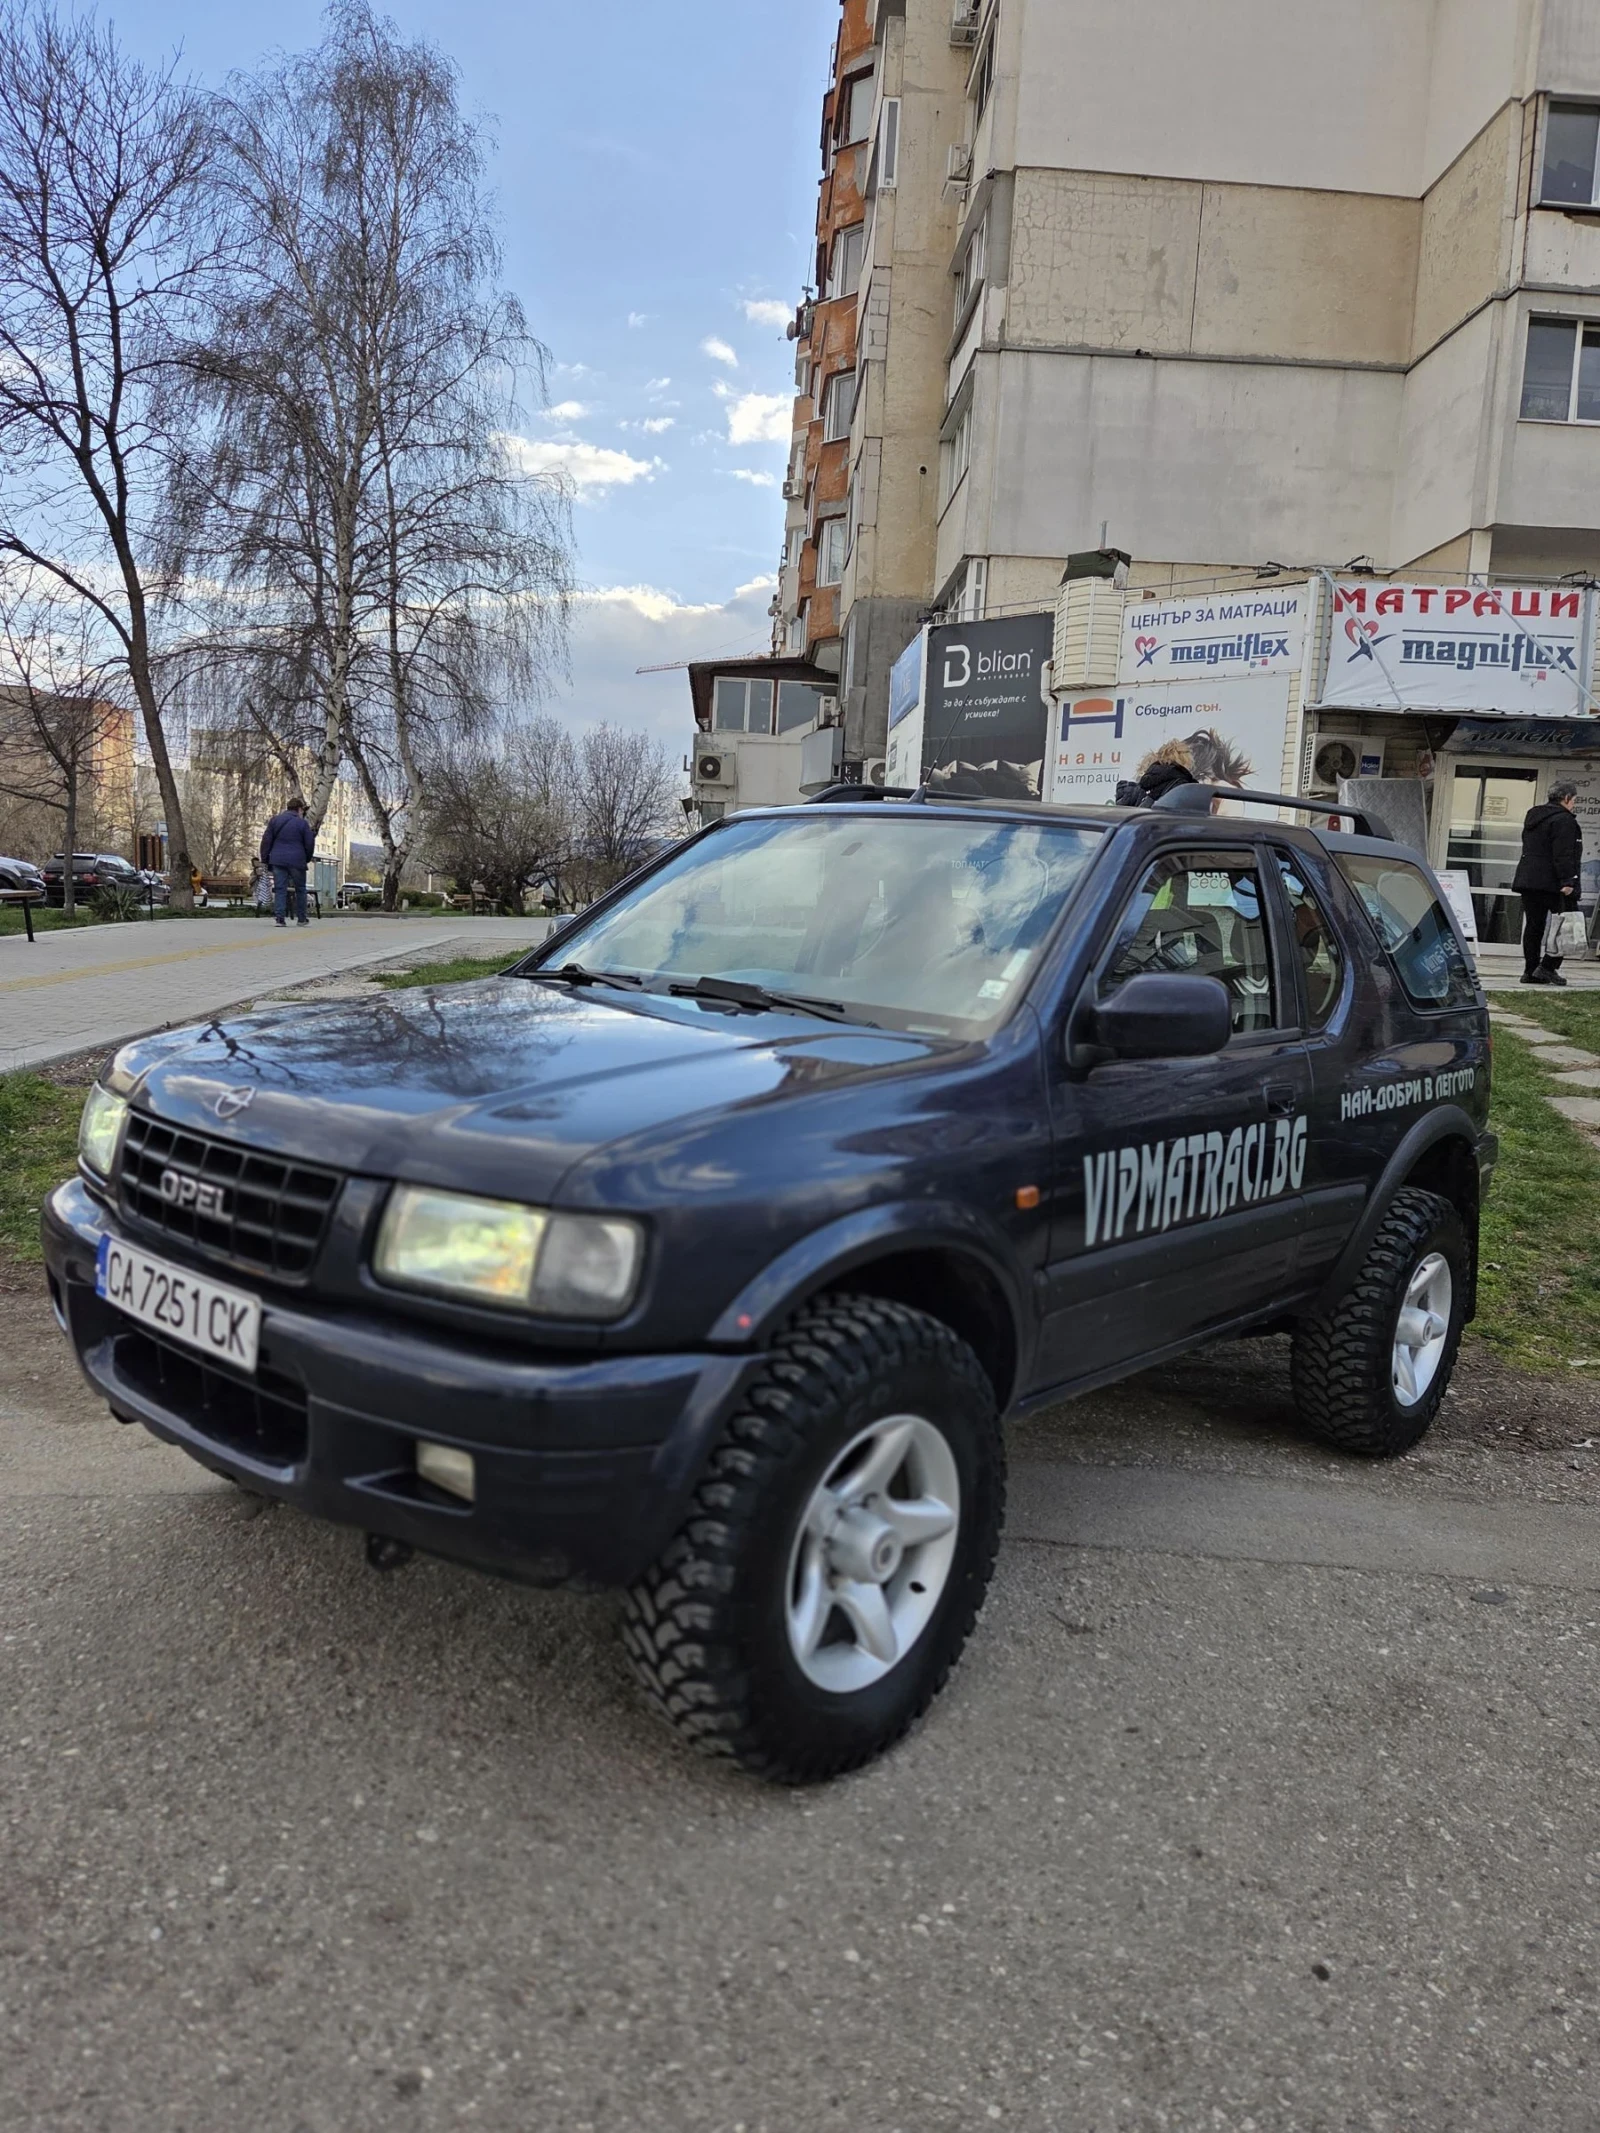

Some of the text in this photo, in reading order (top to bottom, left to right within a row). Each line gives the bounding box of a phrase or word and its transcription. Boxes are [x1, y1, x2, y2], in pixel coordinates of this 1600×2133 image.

[1131, 600, 1298, 630] ЦЕНТЪР ЗА МАТРАЦИ
[1333, 587, 1581, 618] МАТРАЦИ
[977, 649, 1031, 674] blian
[1170, 632, 1290, 665] magniflex
[1135, 702, 1222, 718] Сбъднат сън.
[1058, 750, 1121, 766] нани
[1057, 772, 1120, 785] матраци
[1341, 1079, 1422, 1122] НАЙ-ДОБРИ
[1424, 1077, 1433, 1101] В
[160, 1170, 234, 1222] OPEL
[1083, 1115, 1308, 1247] VIPMATRACI.BG
